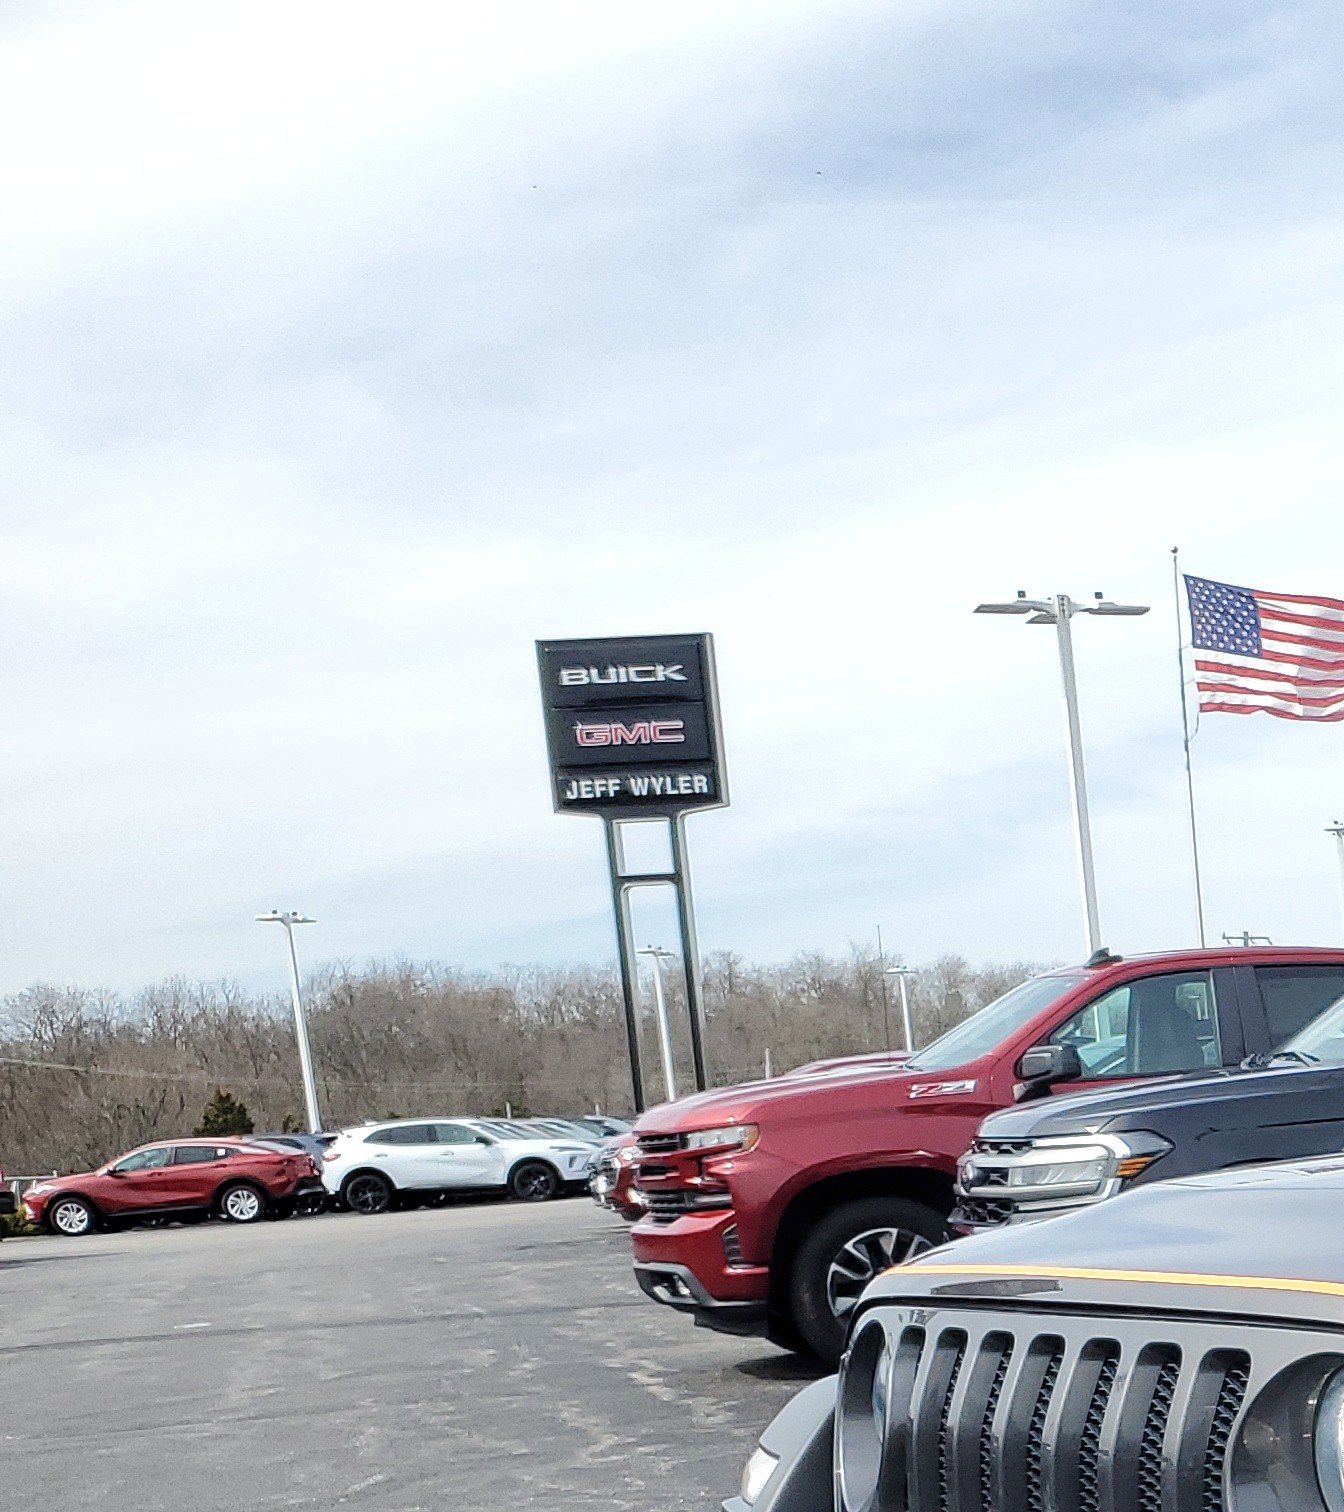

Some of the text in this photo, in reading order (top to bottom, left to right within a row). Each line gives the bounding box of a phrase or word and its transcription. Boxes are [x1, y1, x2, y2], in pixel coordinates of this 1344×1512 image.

[558, 664, 688, 686] BUICK
[575, 720, 685, 747] GMC
[566, 774, 709, 800] JEFF WYLER
